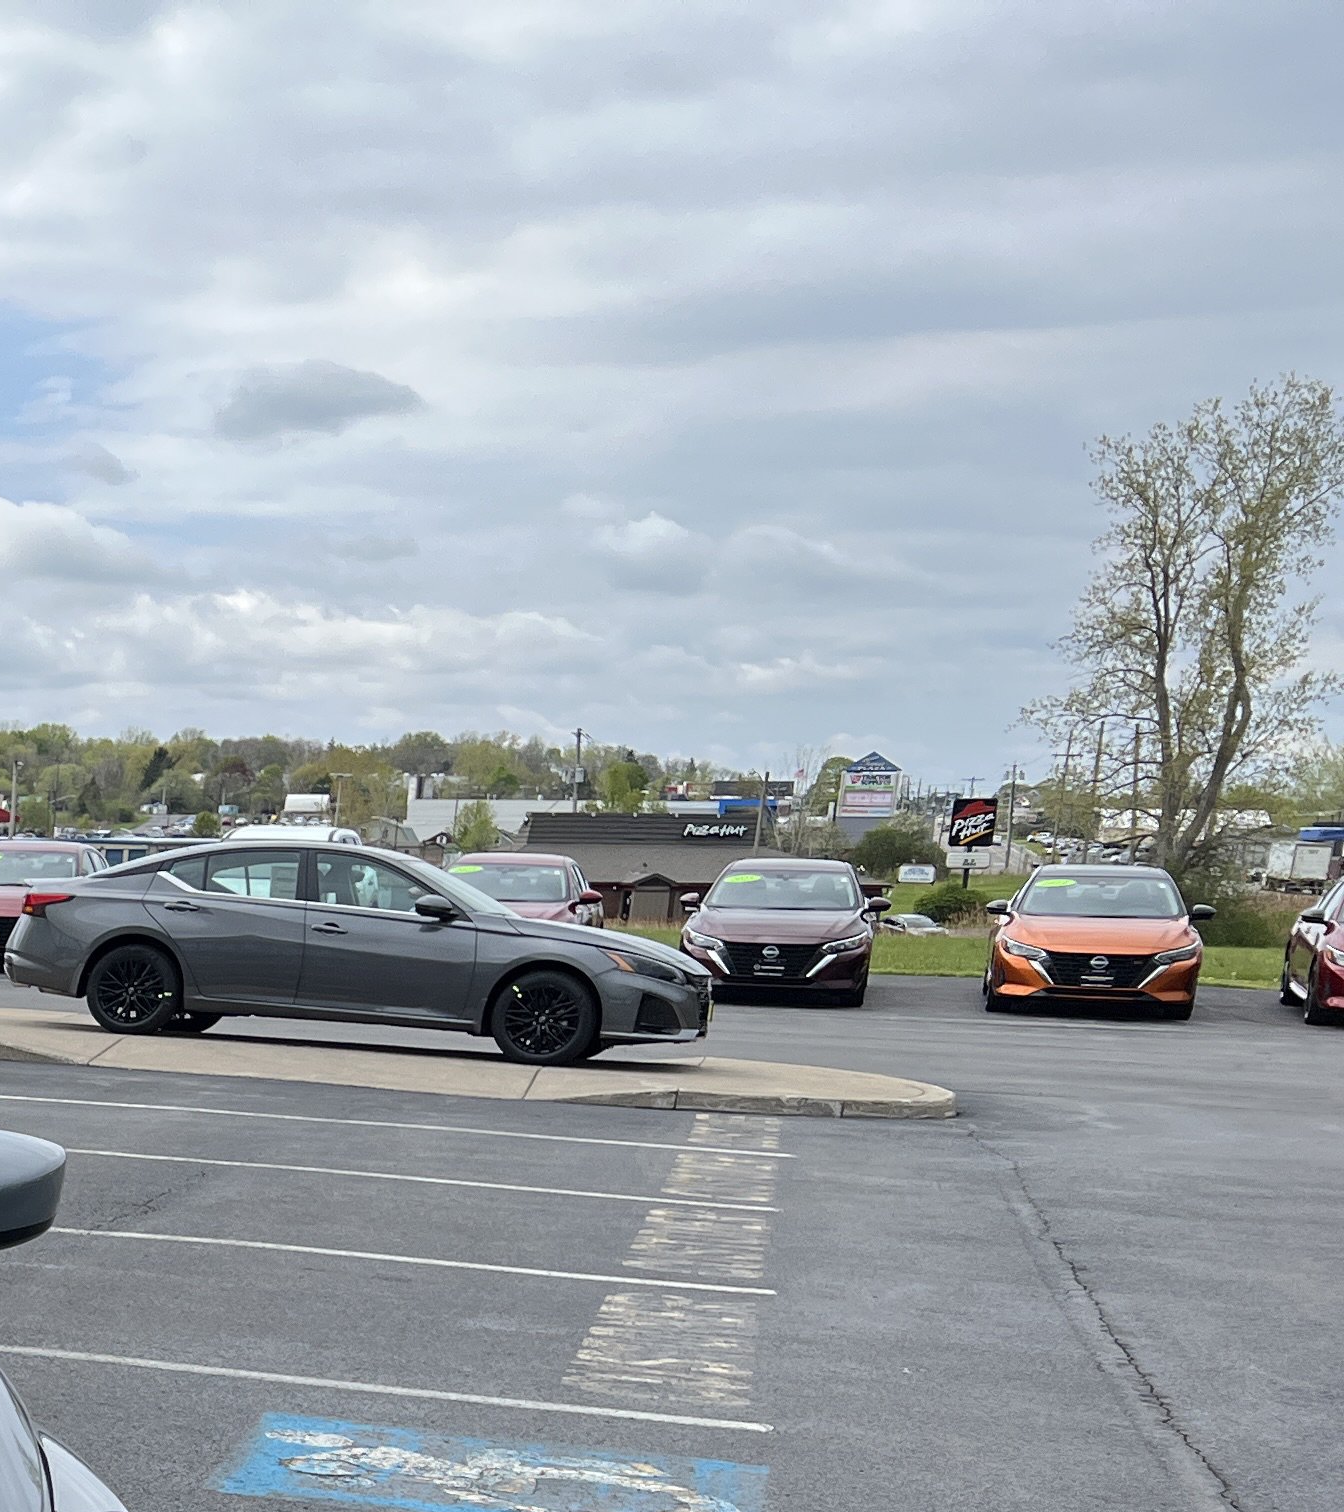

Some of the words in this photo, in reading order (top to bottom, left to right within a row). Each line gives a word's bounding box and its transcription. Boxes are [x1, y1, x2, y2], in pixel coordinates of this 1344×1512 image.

[683, 823, 719, 837] Pizza
[719, 824, 748, 837] Hut
[952, 813, 994, 836] Pizza
[960, 822, 990, 839] Hut
